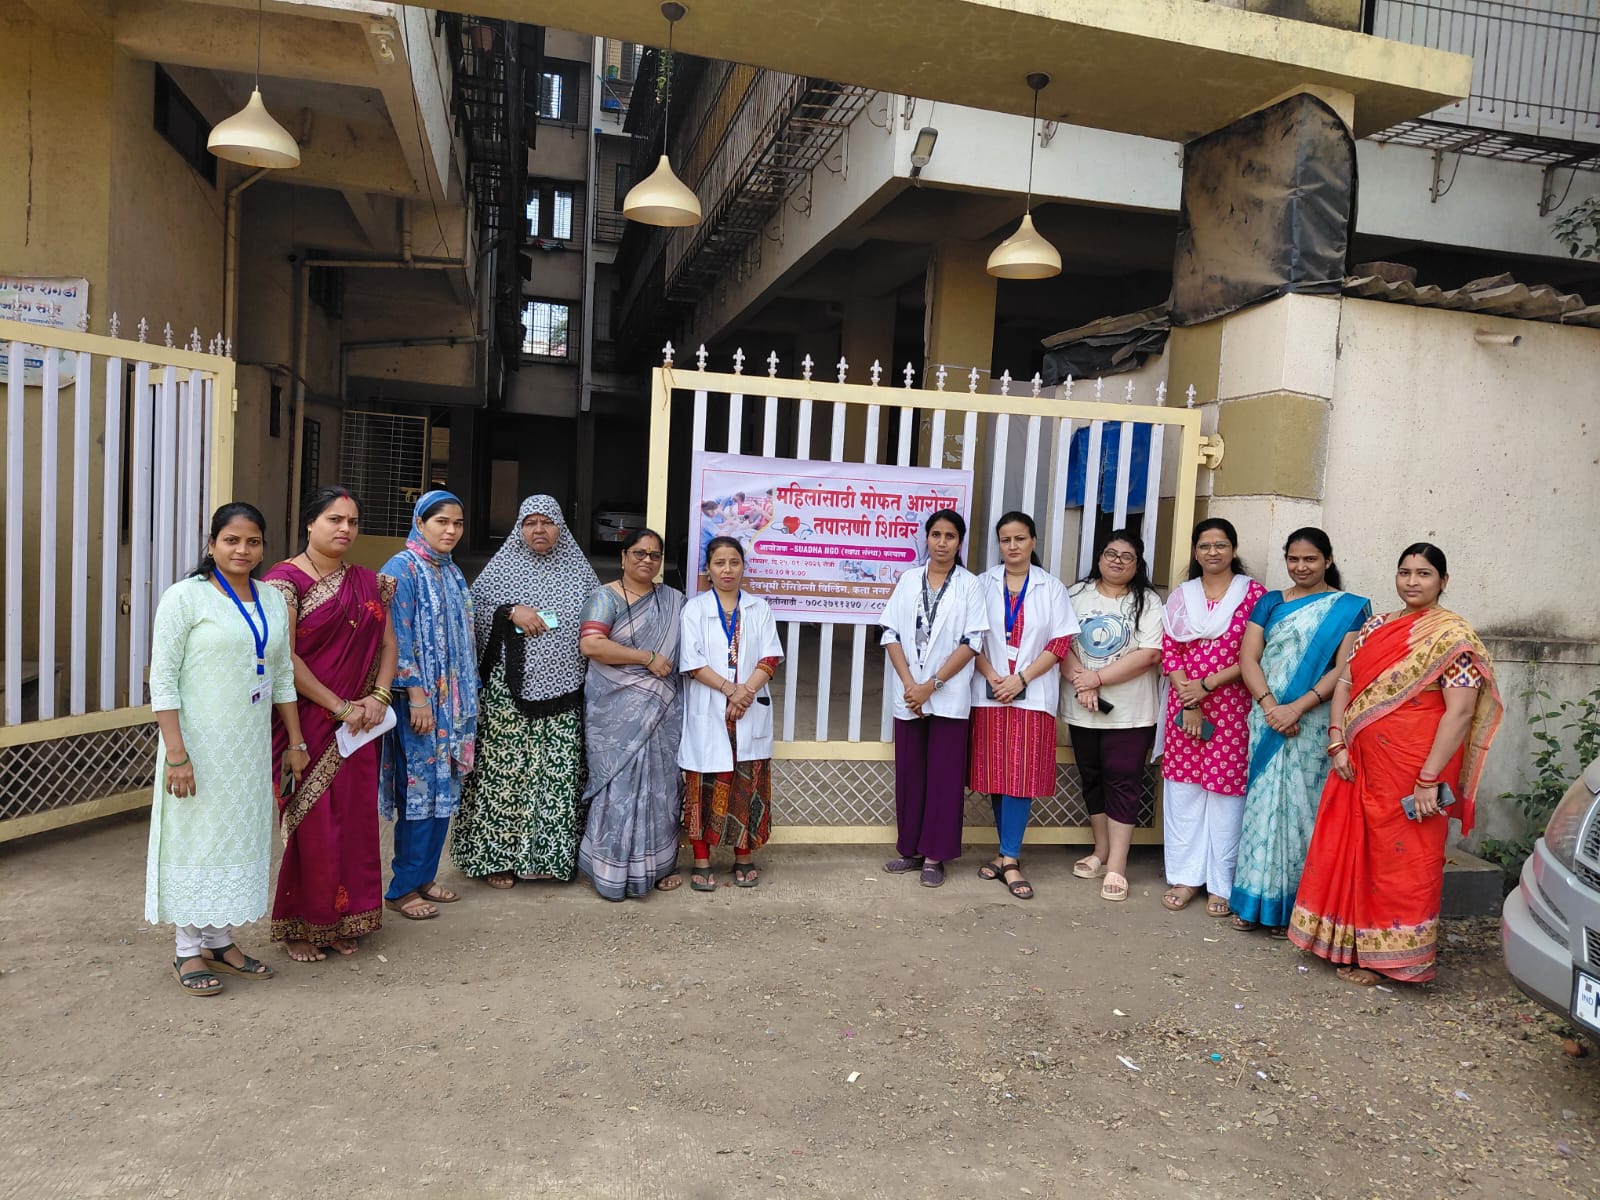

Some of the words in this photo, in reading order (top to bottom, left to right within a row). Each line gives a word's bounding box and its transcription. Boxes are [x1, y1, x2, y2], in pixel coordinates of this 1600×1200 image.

[776, 481, 856, 509] महिलांसाठी
[860, 486, 902, 511] मोफत
[907, 489, 958, 513] आरोग्य
[813, 514, 871, 537] तपासणी
[875, 514, 919, 540] शिबिर
[824, 547, 839, 555] NGO
[1582, 992, 1594, 1006] IND
